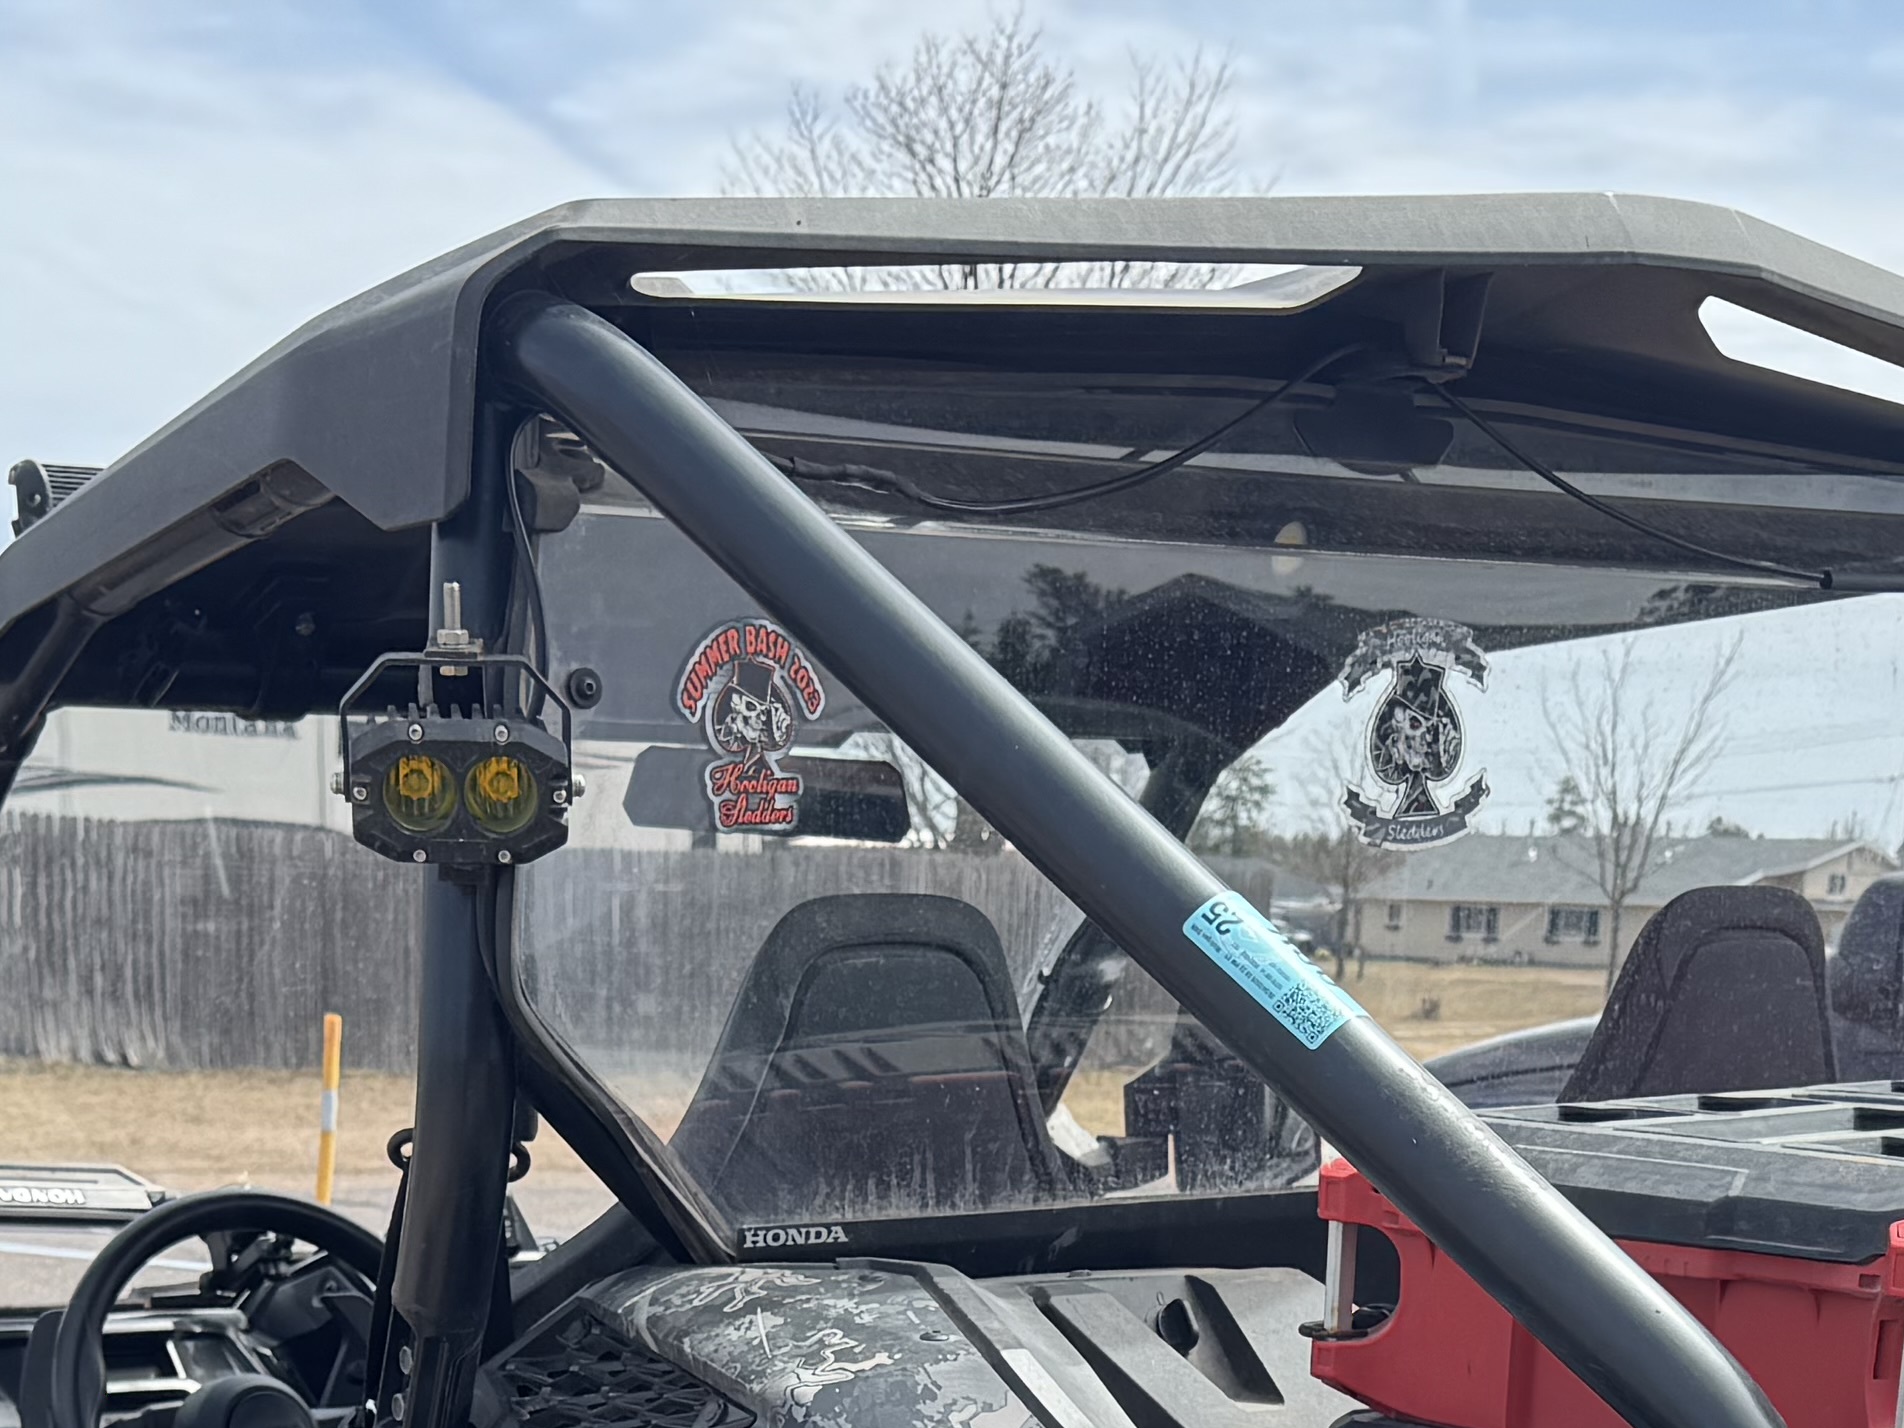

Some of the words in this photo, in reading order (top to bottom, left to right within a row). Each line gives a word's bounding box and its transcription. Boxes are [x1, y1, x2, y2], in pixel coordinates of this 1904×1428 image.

[681, 629, 741, 717] SUMMER
[745, 625, 791, 668] BASH
[712, 764, 800, 800] Hooligan
[720, 795, 794, 827] Sledders
[1387, 821, 1445, 841] Sledders
[1201, 901, 1244, 936] 25
[743, 1226, 849, 1248] HONDA
